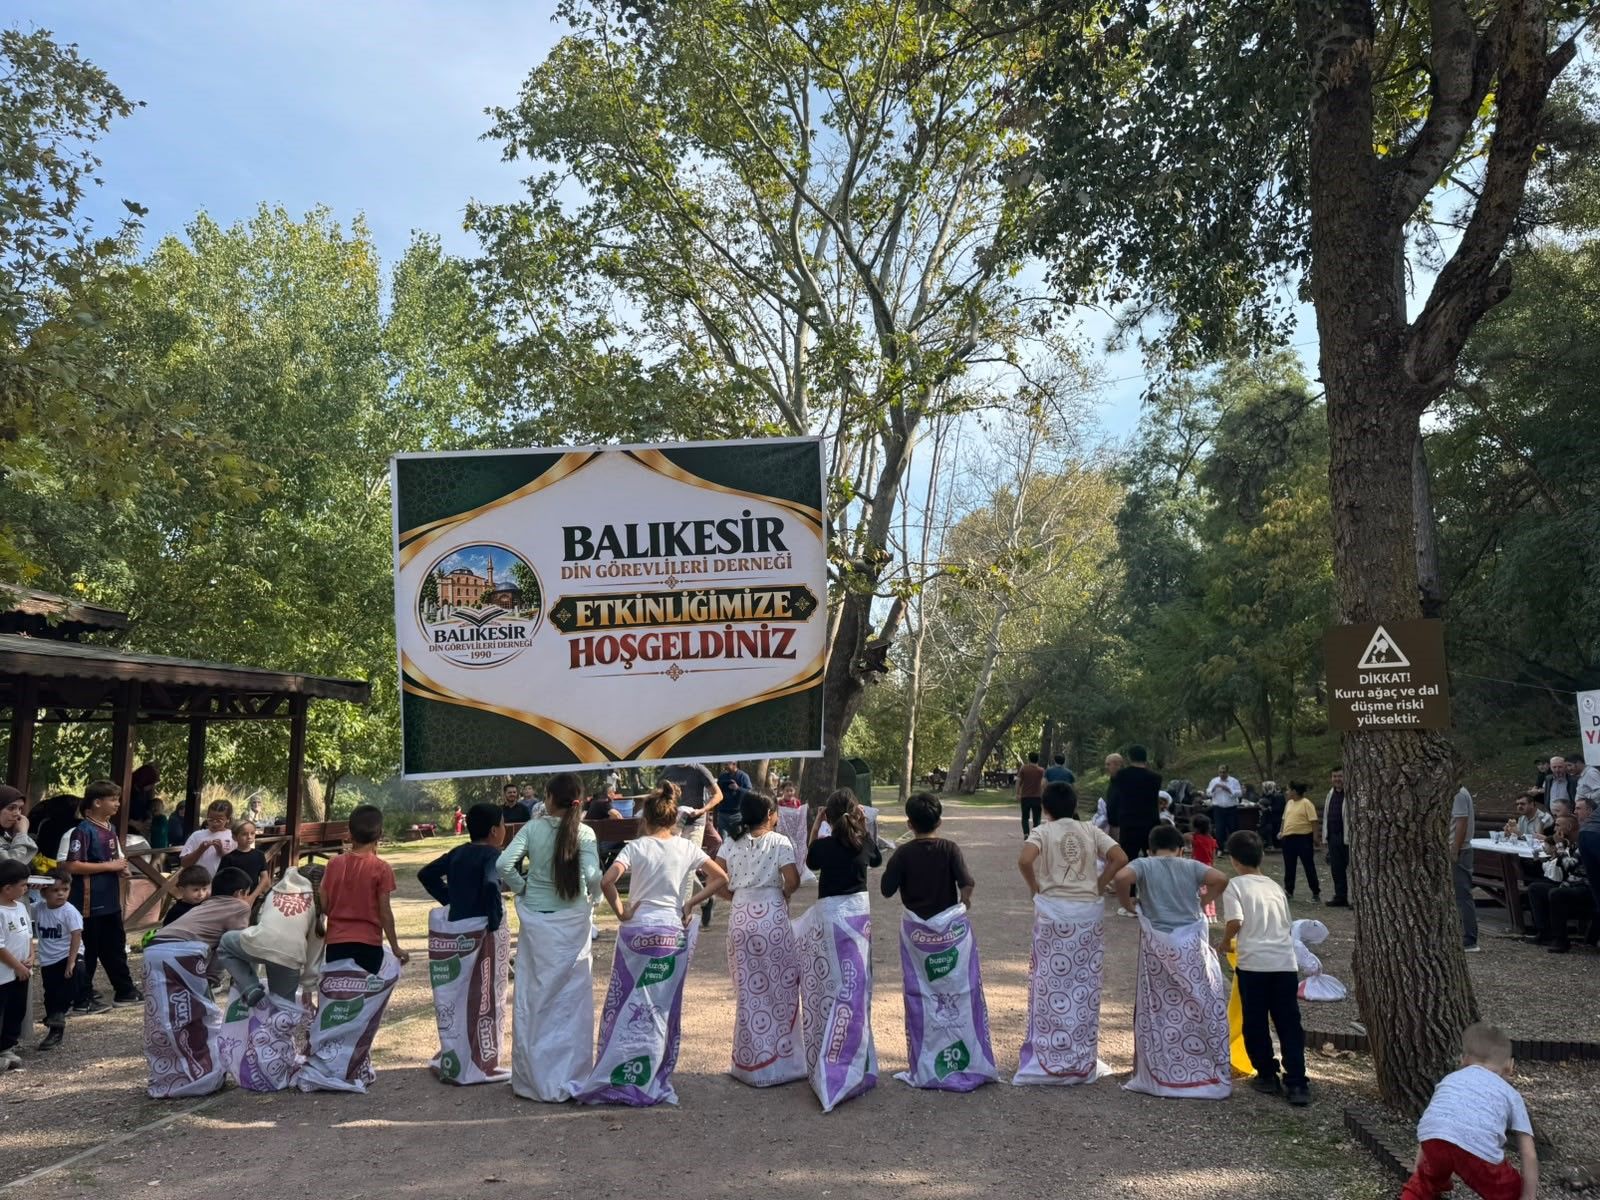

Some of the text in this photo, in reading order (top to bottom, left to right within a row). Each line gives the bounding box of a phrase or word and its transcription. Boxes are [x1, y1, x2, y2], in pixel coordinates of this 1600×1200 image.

[561, 509, 790, 562] BALIKESİR
[561, 552, 793, 580] DİN GÖREVLİLERİ DERNEĞİ
[575, 588, 793, 627] ETKİNLİĞİMİZE
[434, 624, 526, 643] BALIKESİR
[429, 638, 533, 652] DİN GÖREVLİLERİ DERNEĞİ
[568, 623, 797, 670] HOŞGELDİNİZ
[470, 651, 492, 660] 1990
[1359, 672, 1411, 684] DİKKAT!
[1335, 684, 1440, 700] Kuru ağaç ve dal
[1350, 699, 1425, 713] düşme riski
[1357, 713, 1420, 727] yüksektir.
[633, 934, 676, 948] dostum
[479, 1019, 497, 1061] yarış
[828, 1004, 853, 1064] dostum
[943, 1048, 961, 1062] 50
[622, 1060, 644, 1074] 50
[624, 1073, 637, 1083] Kg
